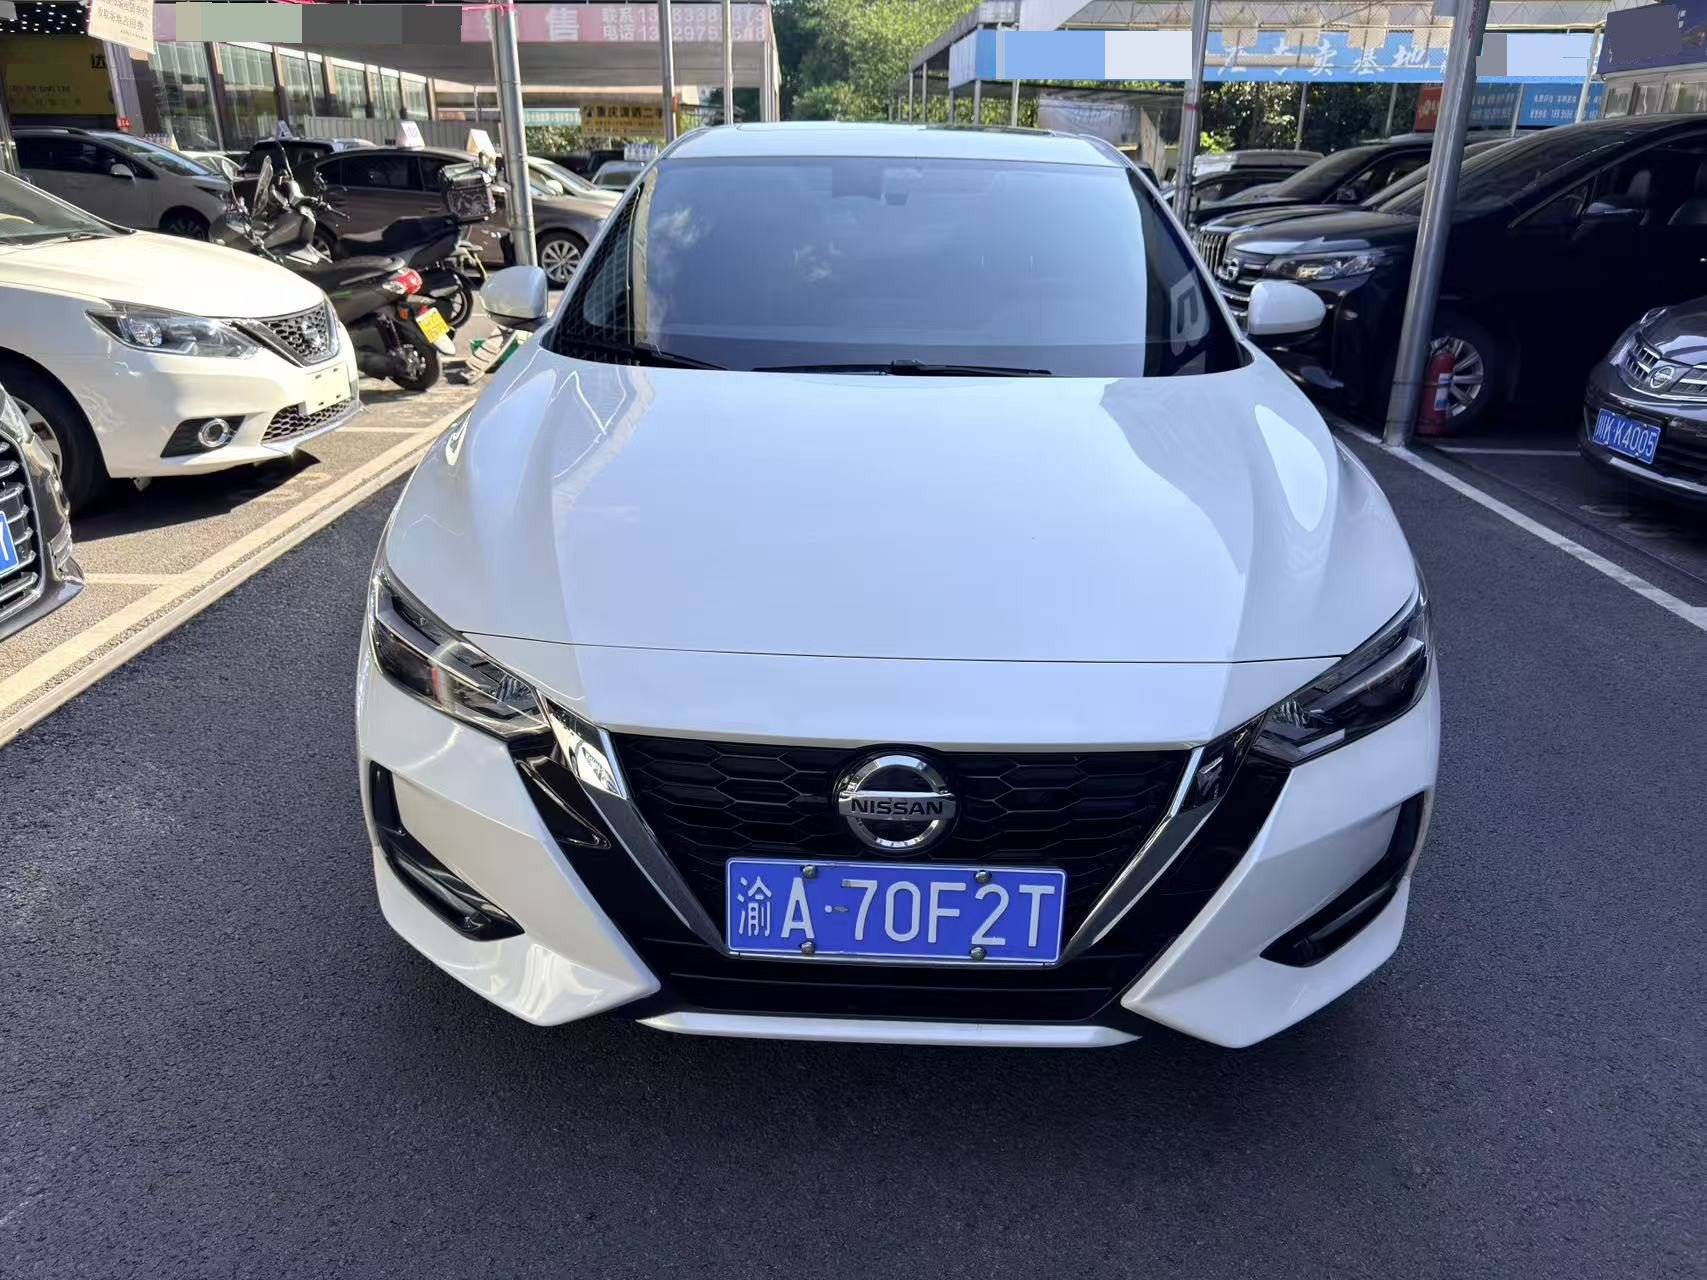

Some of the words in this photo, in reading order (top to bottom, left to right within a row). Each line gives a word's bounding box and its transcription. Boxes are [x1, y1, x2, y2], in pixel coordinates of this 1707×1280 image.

[601, 7, 634, 23] 联系
[603, 24, 634, 40] 电话
[850, 798, 944, 817] NISSAN
